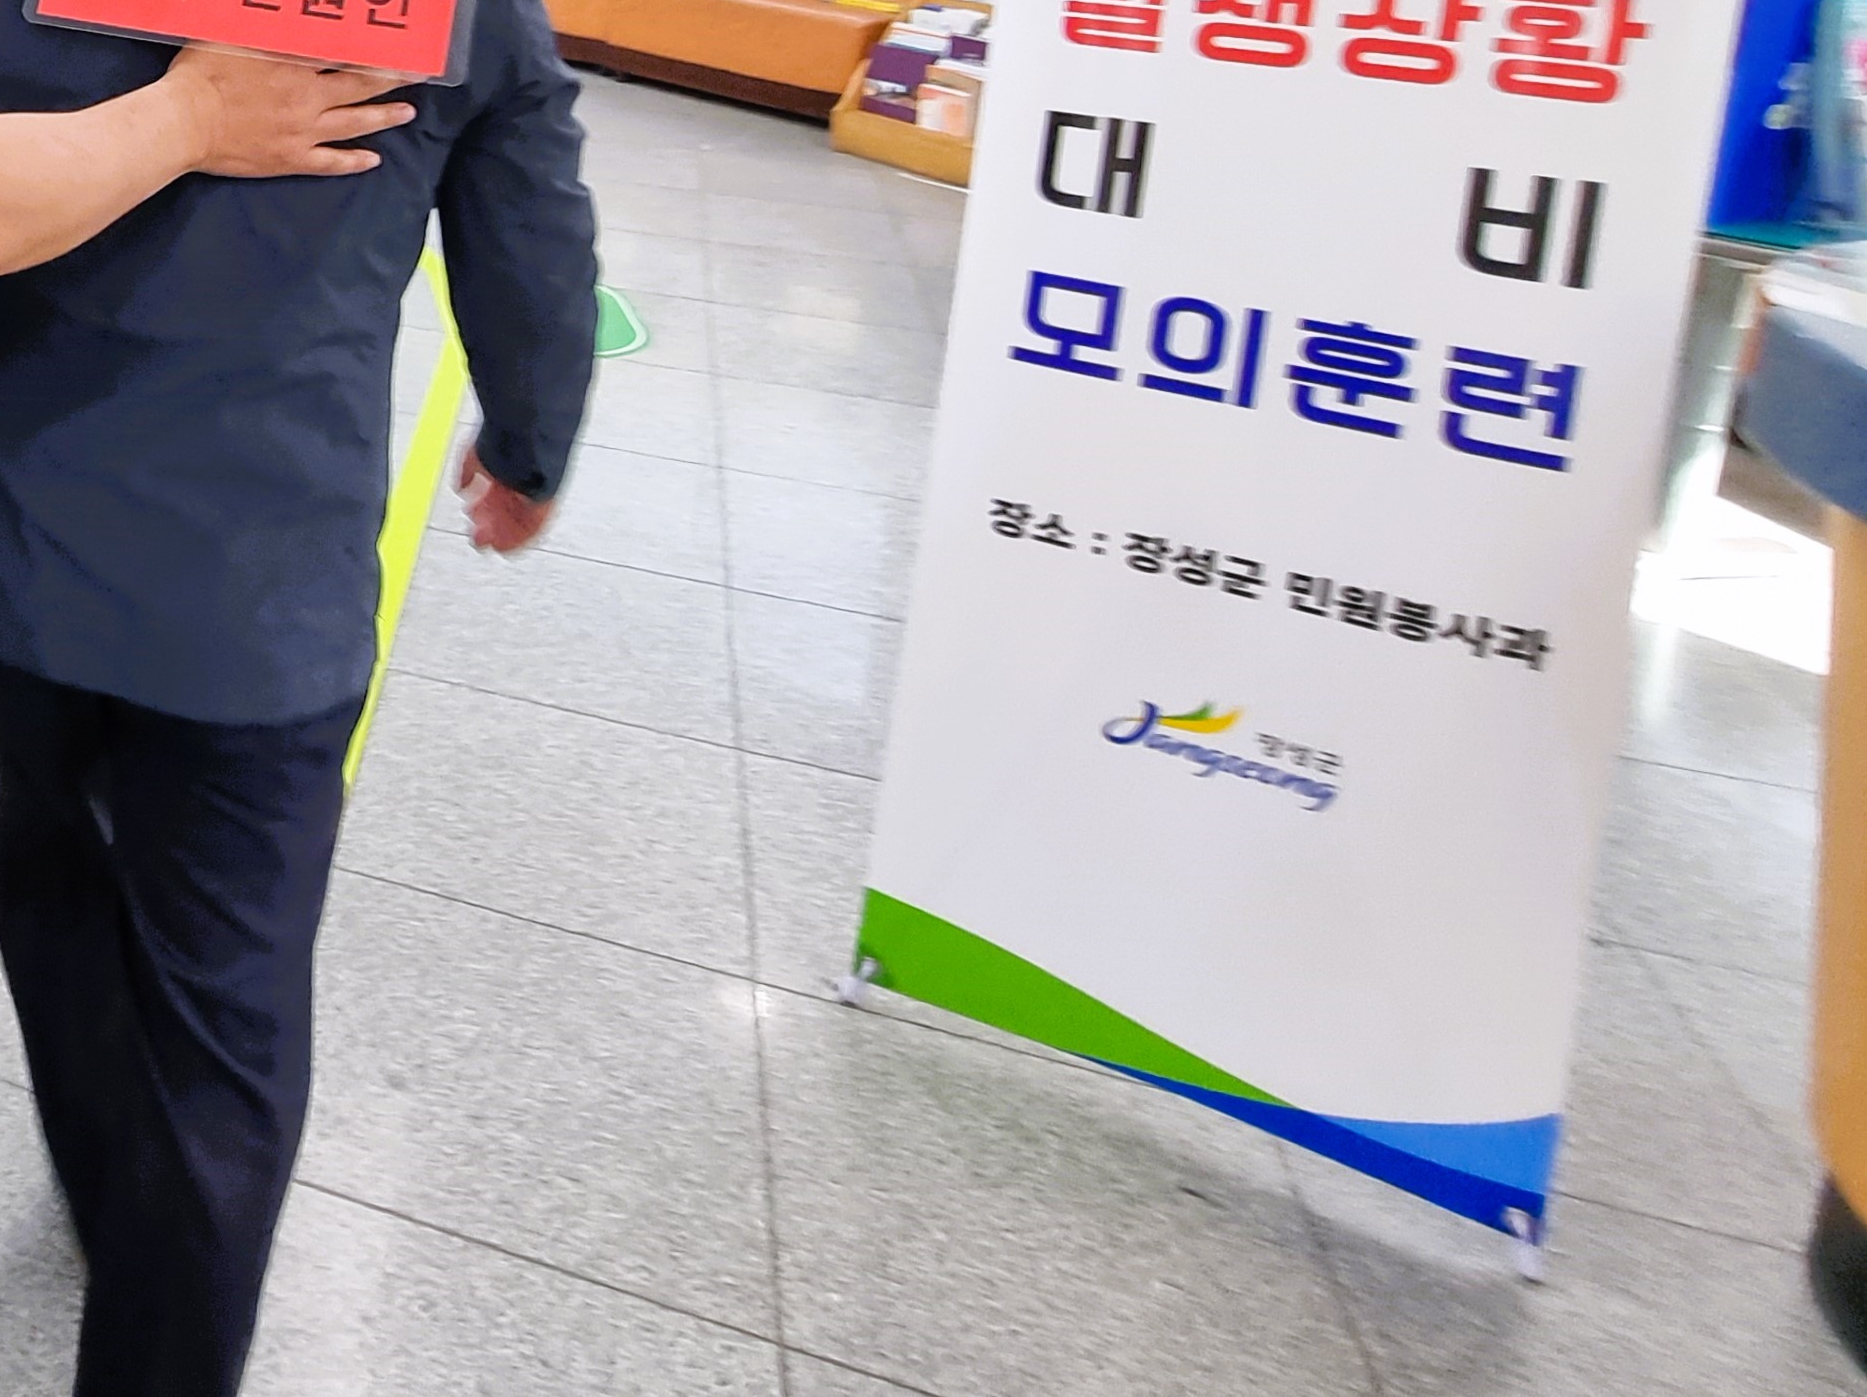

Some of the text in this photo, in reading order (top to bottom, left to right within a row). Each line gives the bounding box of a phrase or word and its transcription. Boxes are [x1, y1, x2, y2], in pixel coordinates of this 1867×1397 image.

[1008, 270, 1586, 471] 모의훈련
[988, 499, 1074, 549] 장소
[1123, 532, 1267, 600] 장성군
[1284, 571, 1554, 672] 민원봉사과
